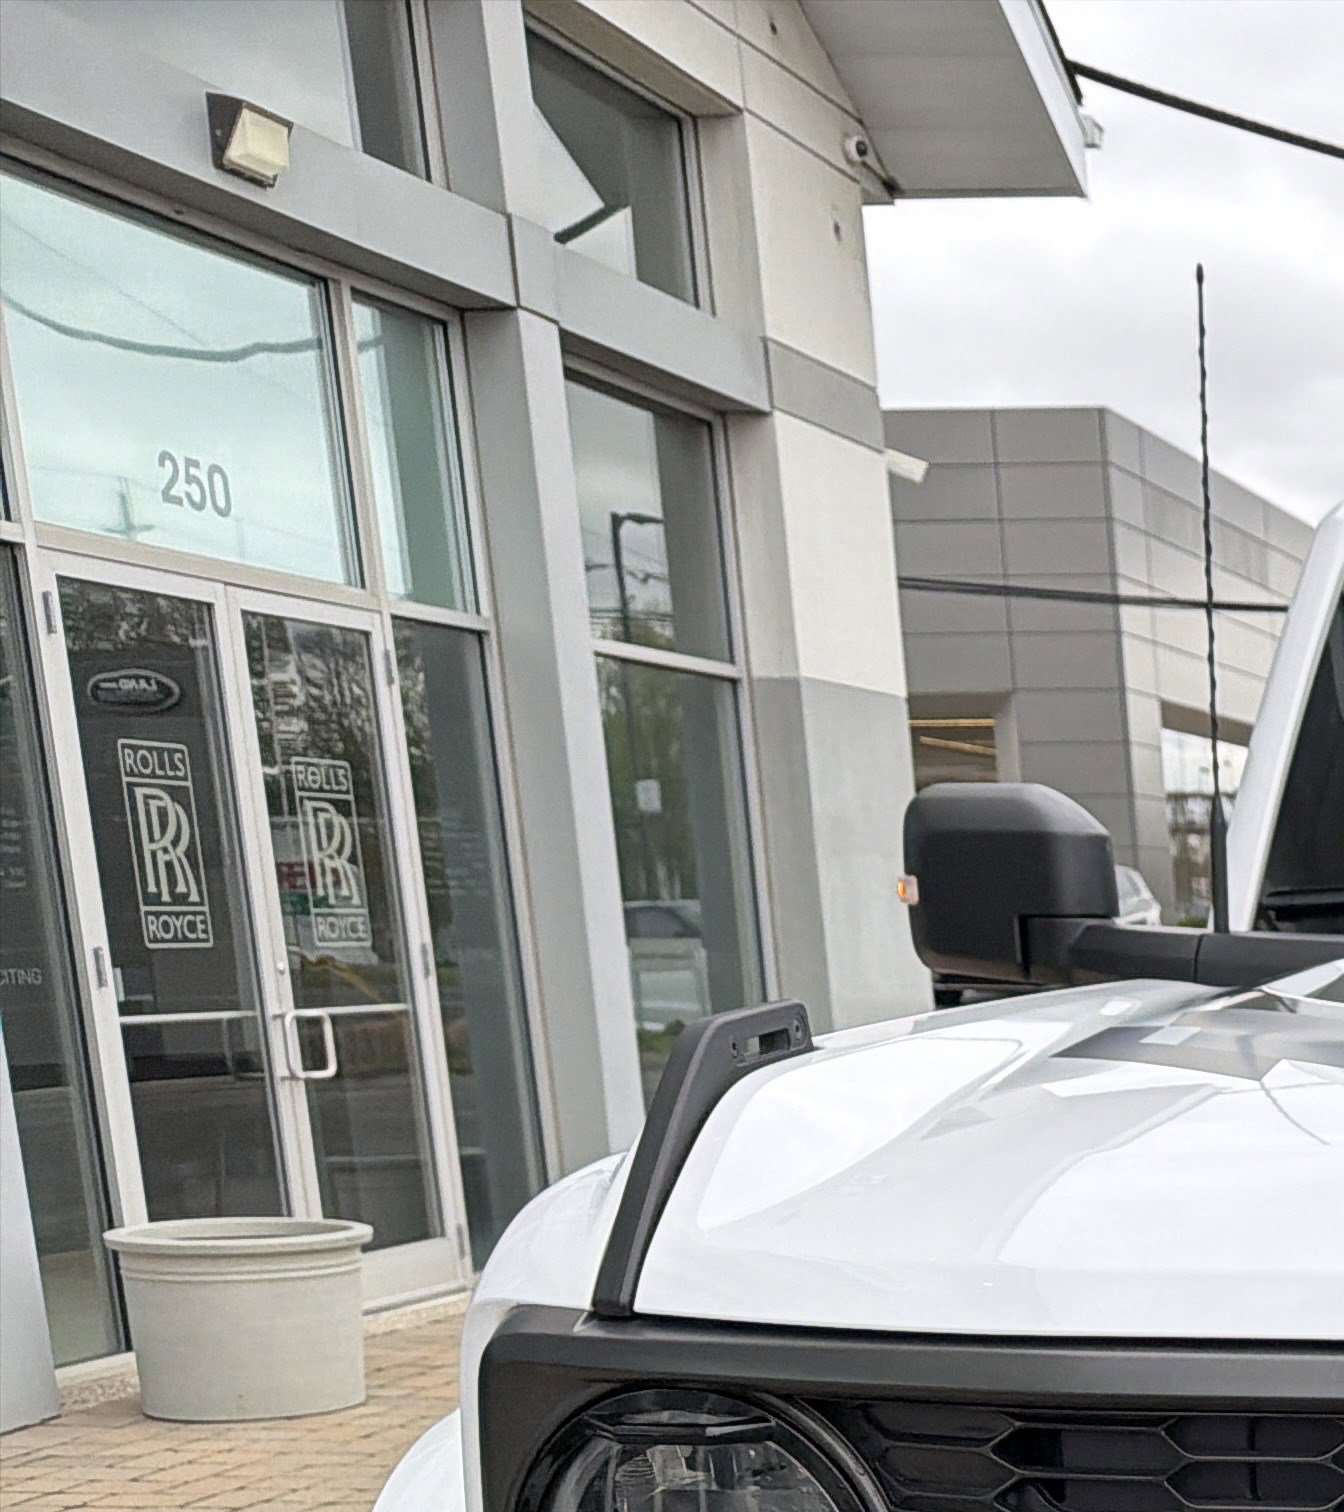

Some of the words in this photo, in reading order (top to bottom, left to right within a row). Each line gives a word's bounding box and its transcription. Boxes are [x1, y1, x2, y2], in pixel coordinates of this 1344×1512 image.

[157, 449, 232, 518] 250
[124, 748, 186, 776] ROLLS
[296, 764, 349, 791] ROLLS
[149, 914, 208, 941] ROYCE
[316, 915, 368, 941] ROYCE
